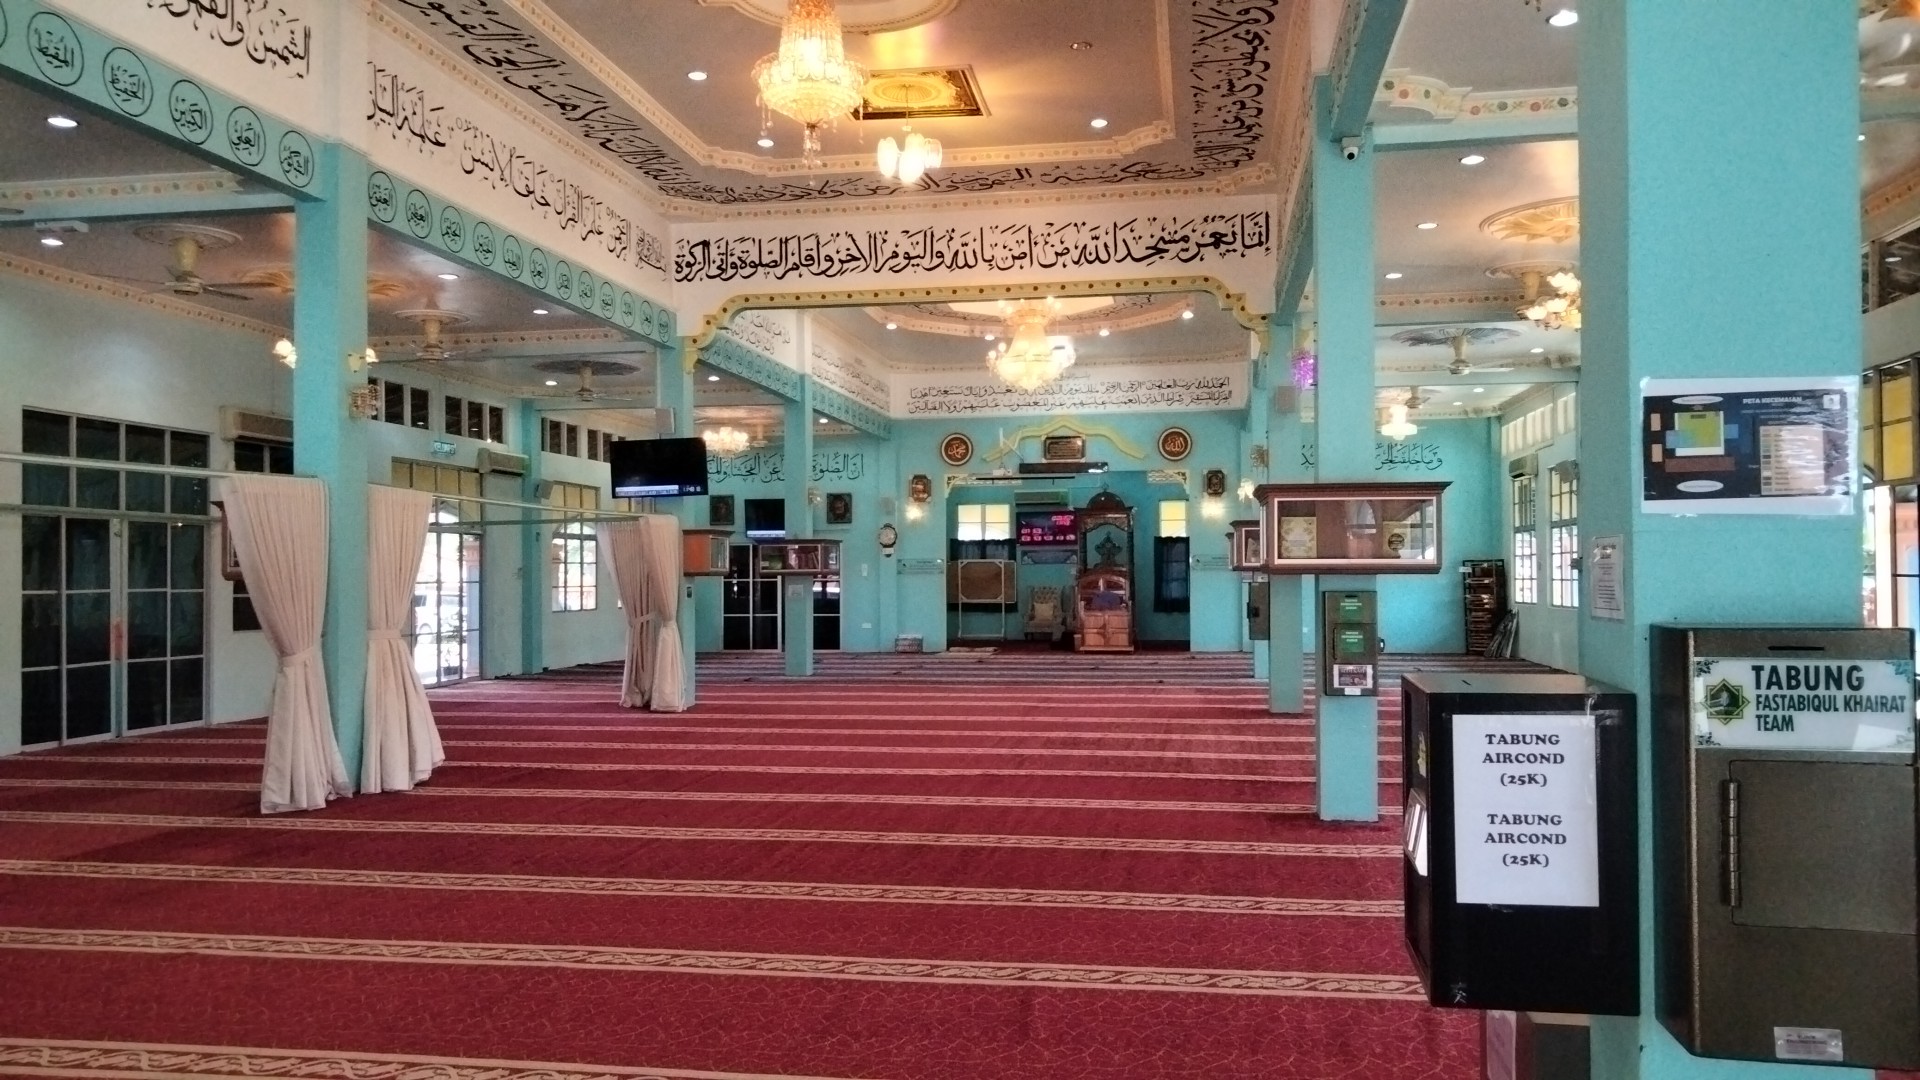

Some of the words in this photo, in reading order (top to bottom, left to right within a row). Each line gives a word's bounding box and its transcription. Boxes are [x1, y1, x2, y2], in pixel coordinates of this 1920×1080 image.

[1751, 664, 1865, 692] TABUNG
[1755, 693, 1839, 712] FASTABIQUL
[1843, 694, 1907, 713] KHAIRAT
[1755, 714, 1795, 732] TEAM
[1484, 734, 1561, 746] TABUNG
[1482, 752, 1566, 765] AIRCOND
[1500, 772, 1548, 788] (25K)
[1486, 813, 1563, 826] TABUNG
[1484, 832, 1568, 845] AIRCOND
[1502, 853, 1550, 868] (25K)
